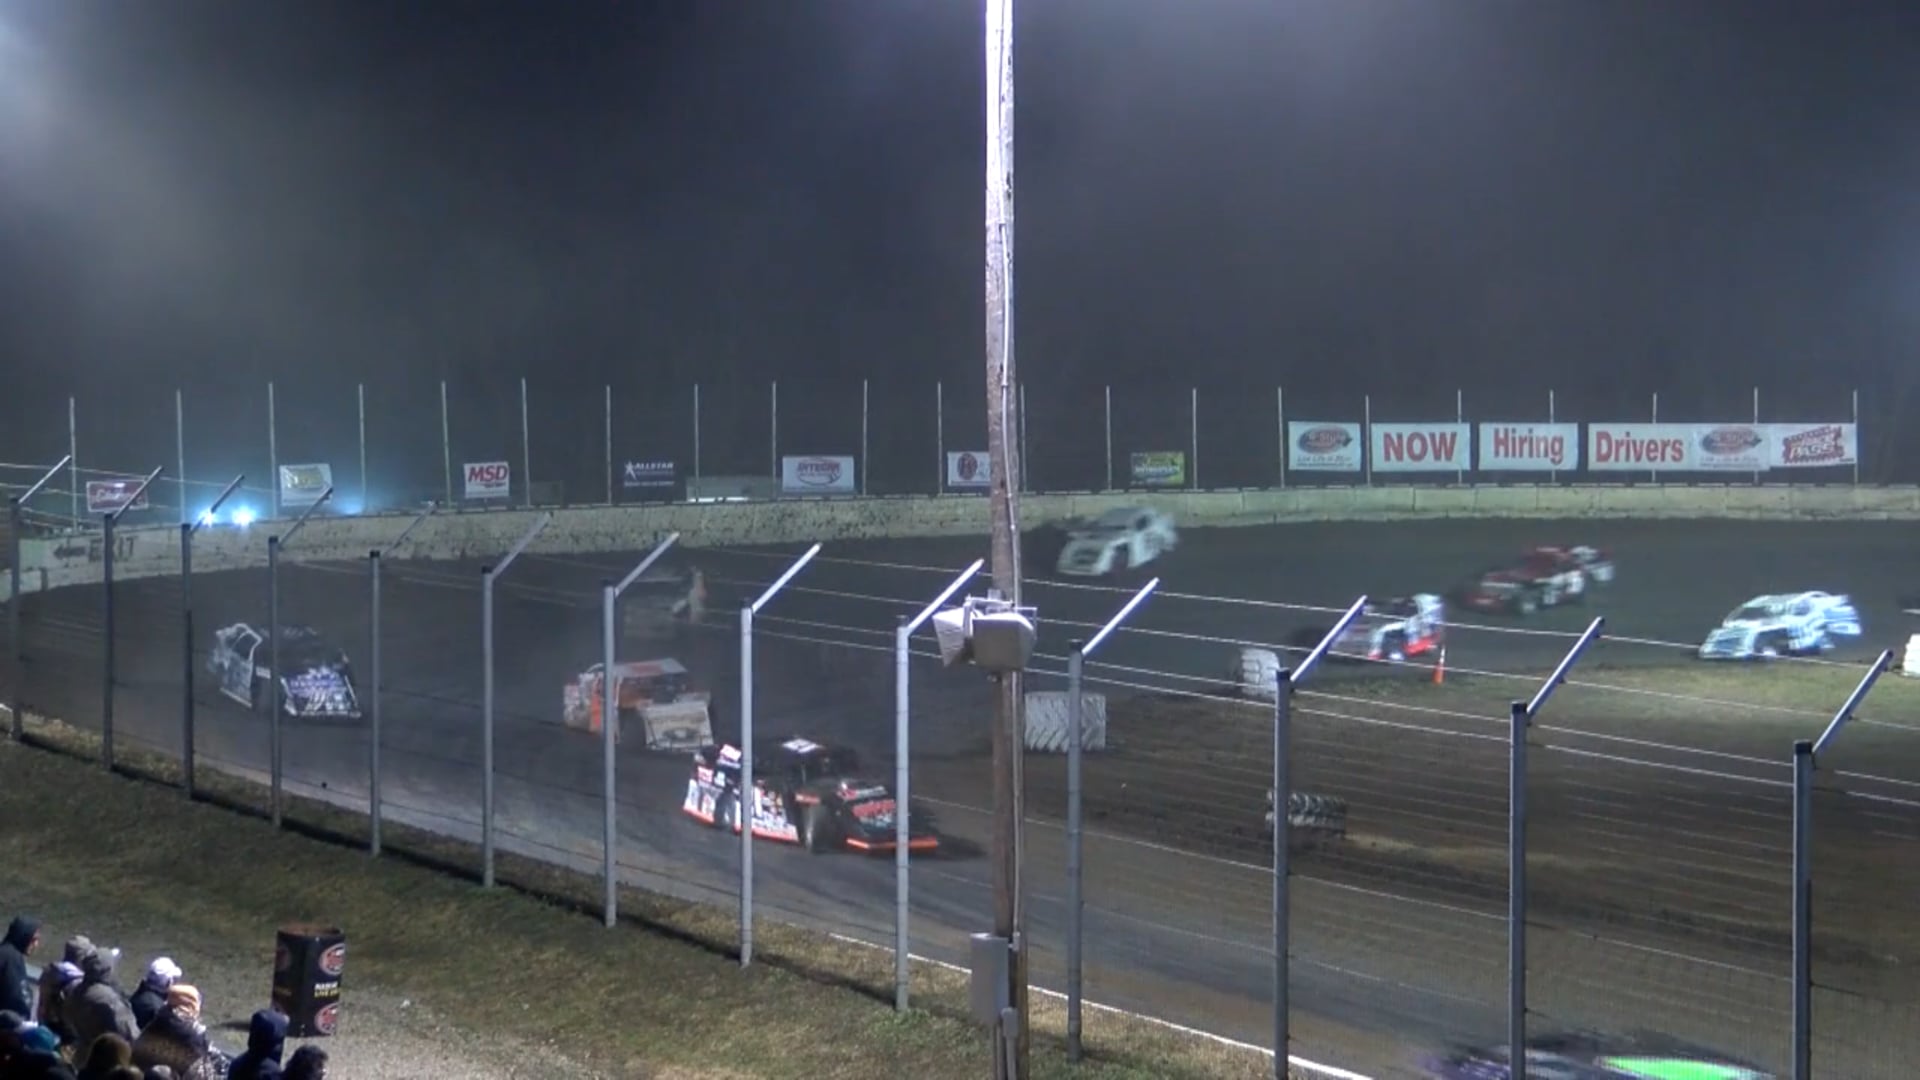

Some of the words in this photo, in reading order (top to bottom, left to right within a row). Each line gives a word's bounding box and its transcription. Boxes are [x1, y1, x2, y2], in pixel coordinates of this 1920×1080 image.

[1383, 431, 1457, 462] NOW
[1493, 427, 1564, 465] Hiring
[1595, 431, 1684, 463] Drivers
[468, 465, 508, 482] MSD
[634, 461, 674, 470] ALLSTAR
[89, 536, 136, 561] EIT
